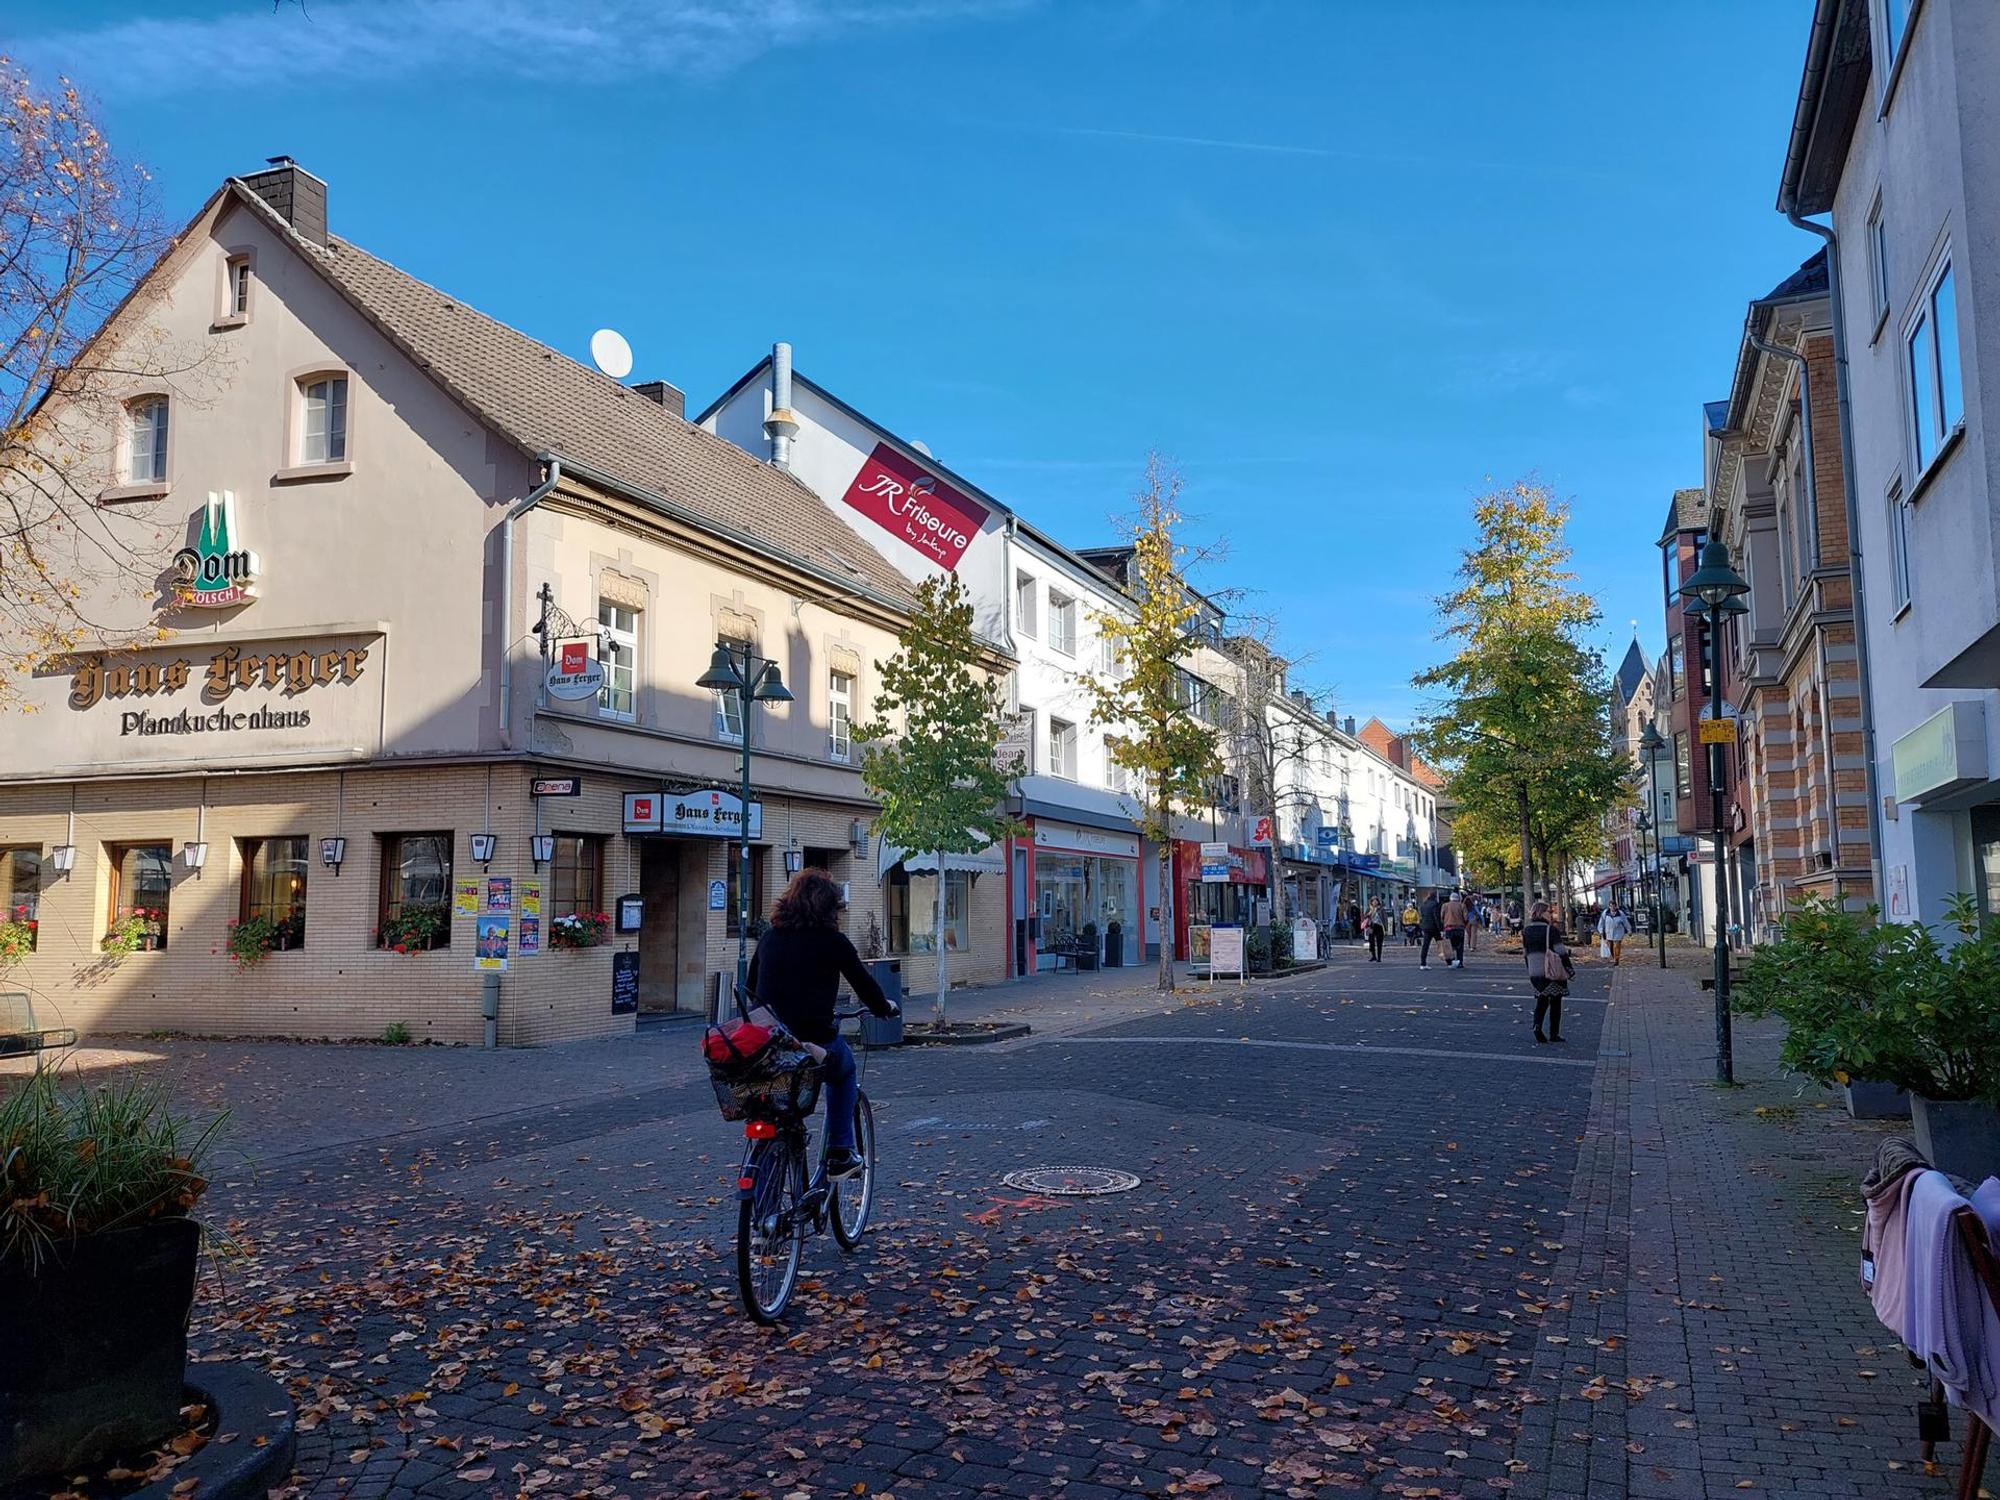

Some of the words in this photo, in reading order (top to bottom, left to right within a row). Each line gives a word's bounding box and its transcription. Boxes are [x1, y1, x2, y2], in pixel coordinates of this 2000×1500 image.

[905, 522, 917, 540] by
[171, 547, 252, 586] Dom
[565, 654, 584, 665] Dom
[72, 657, 191, 706] Haus
[204, 646, 369, 701] Ferger
[549, 675, 571, 687] Haus
[120, 704, 311, 736] Pfannkuchenhaus
[996, 748, 1021, 759] Jean
[675, 803, 710, 821] Haus
